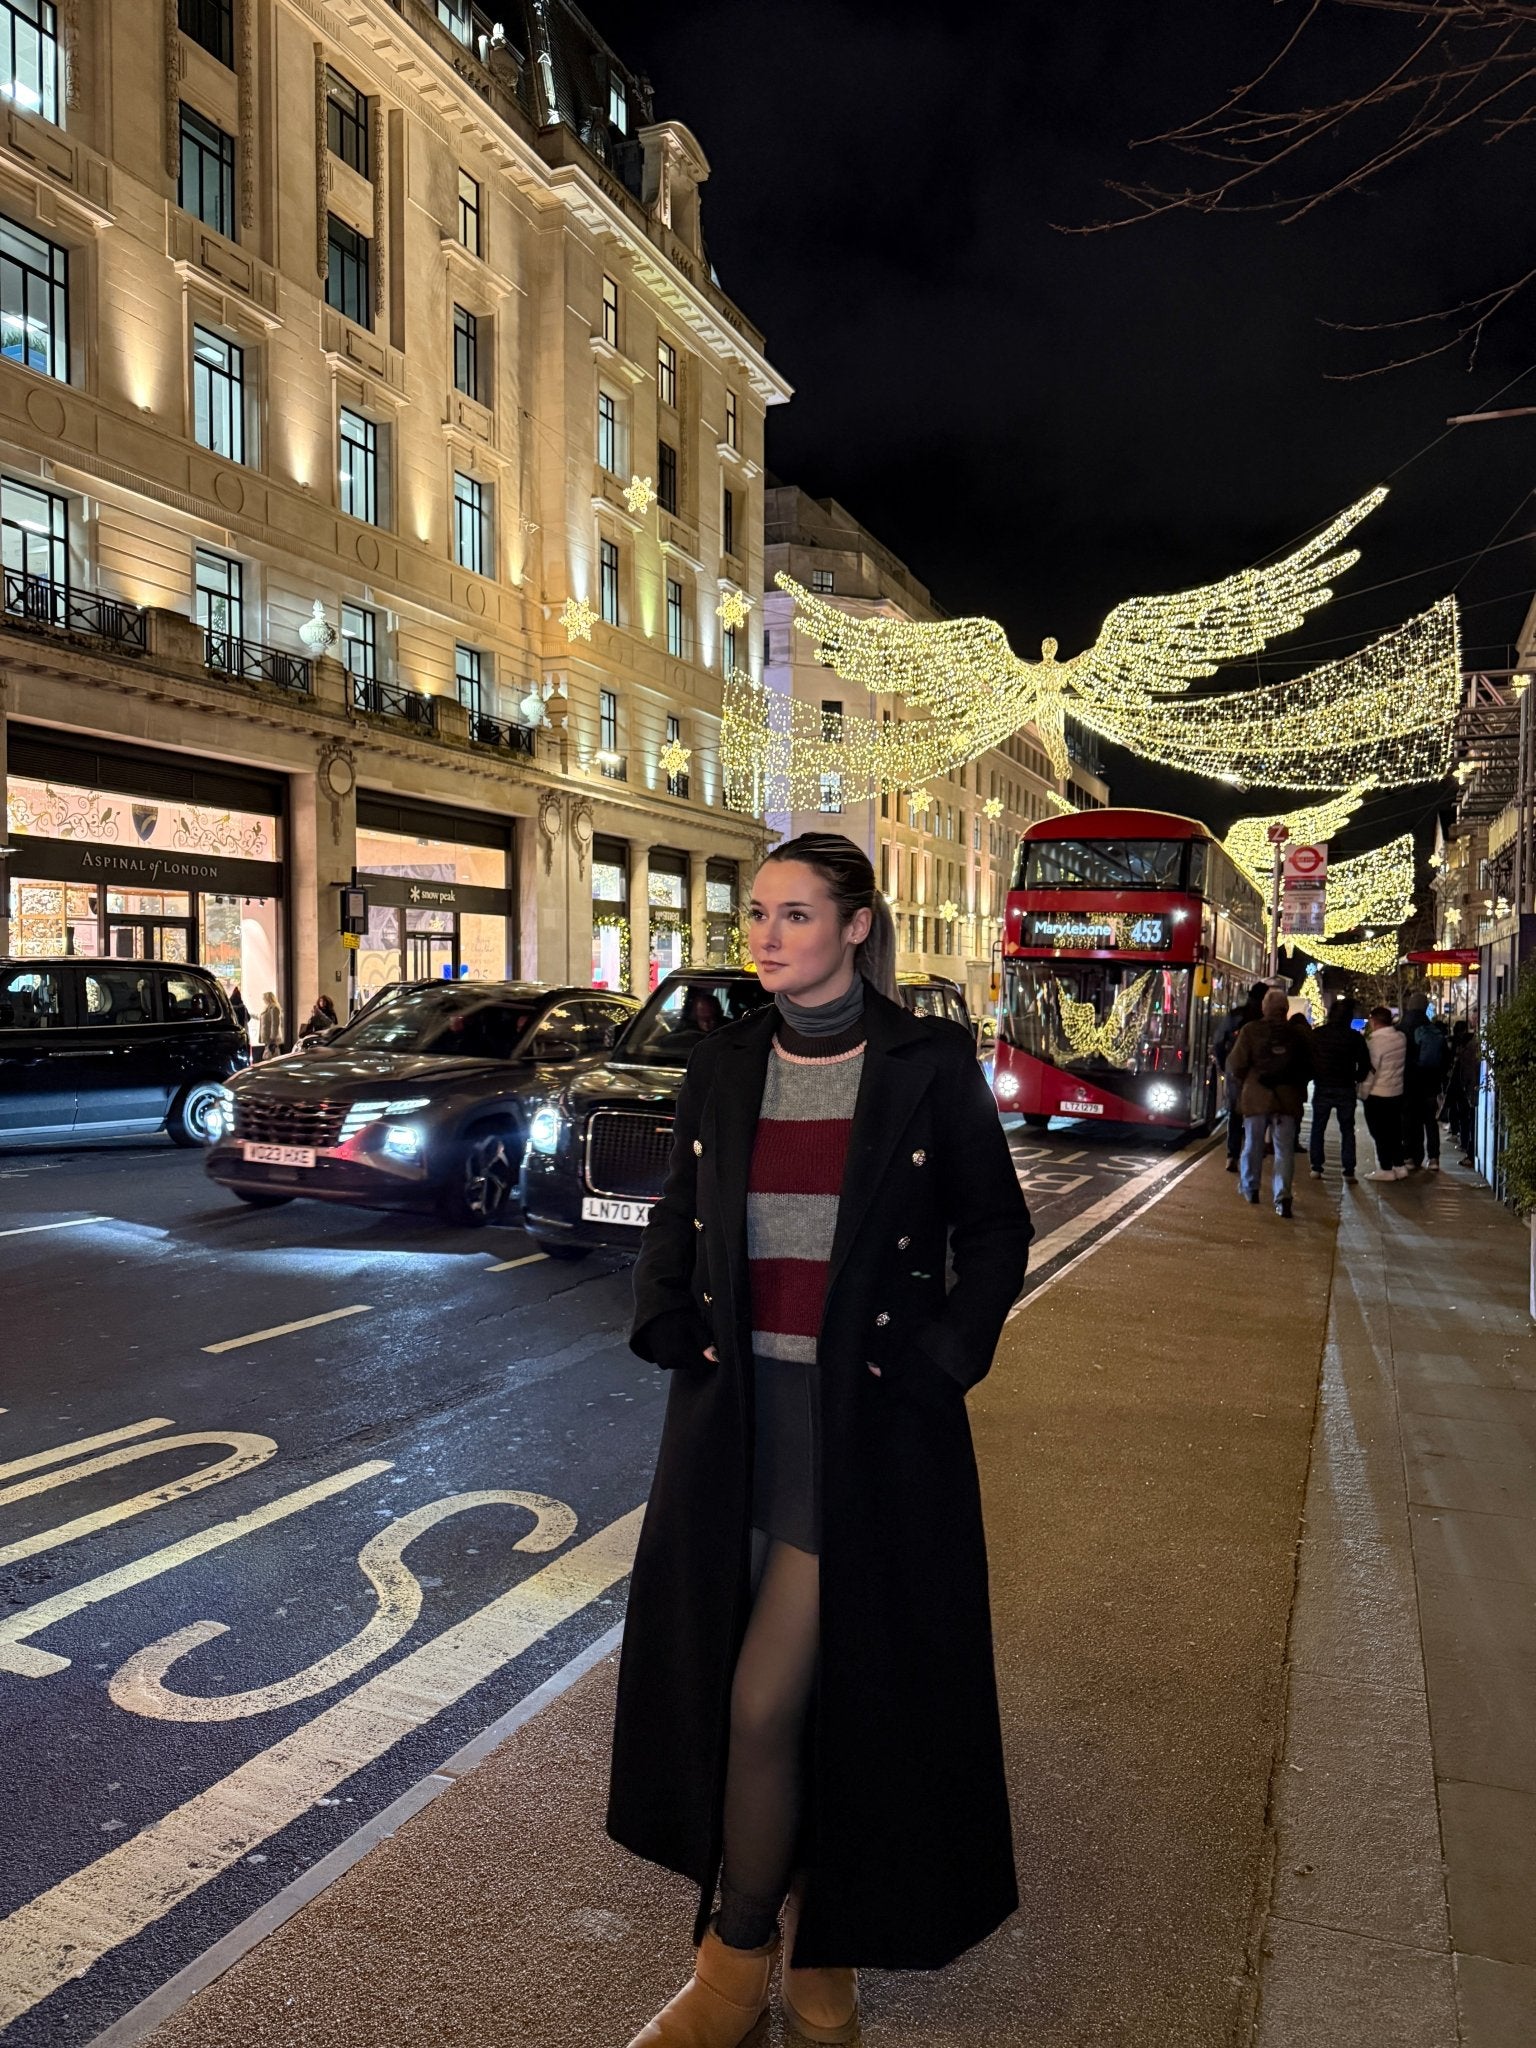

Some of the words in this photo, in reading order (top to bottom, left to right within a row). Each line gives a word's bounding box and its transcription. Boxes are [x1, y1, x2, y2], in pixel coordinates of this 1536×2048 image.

[1272, 825, 1285, 842] Z
[82, 851, 146, 871] ASPINAL
[150, 860, 162, 881] of
[164, 863, 218, 877] LONDON
[421, 890, 438, 899] snow
[439, 890, 456, 904] peak
[1034, 921, 1112, 938] Marylebone
[1130, 919, 1162, 943] 453
[590, 1200, 631, 1221] LN70
